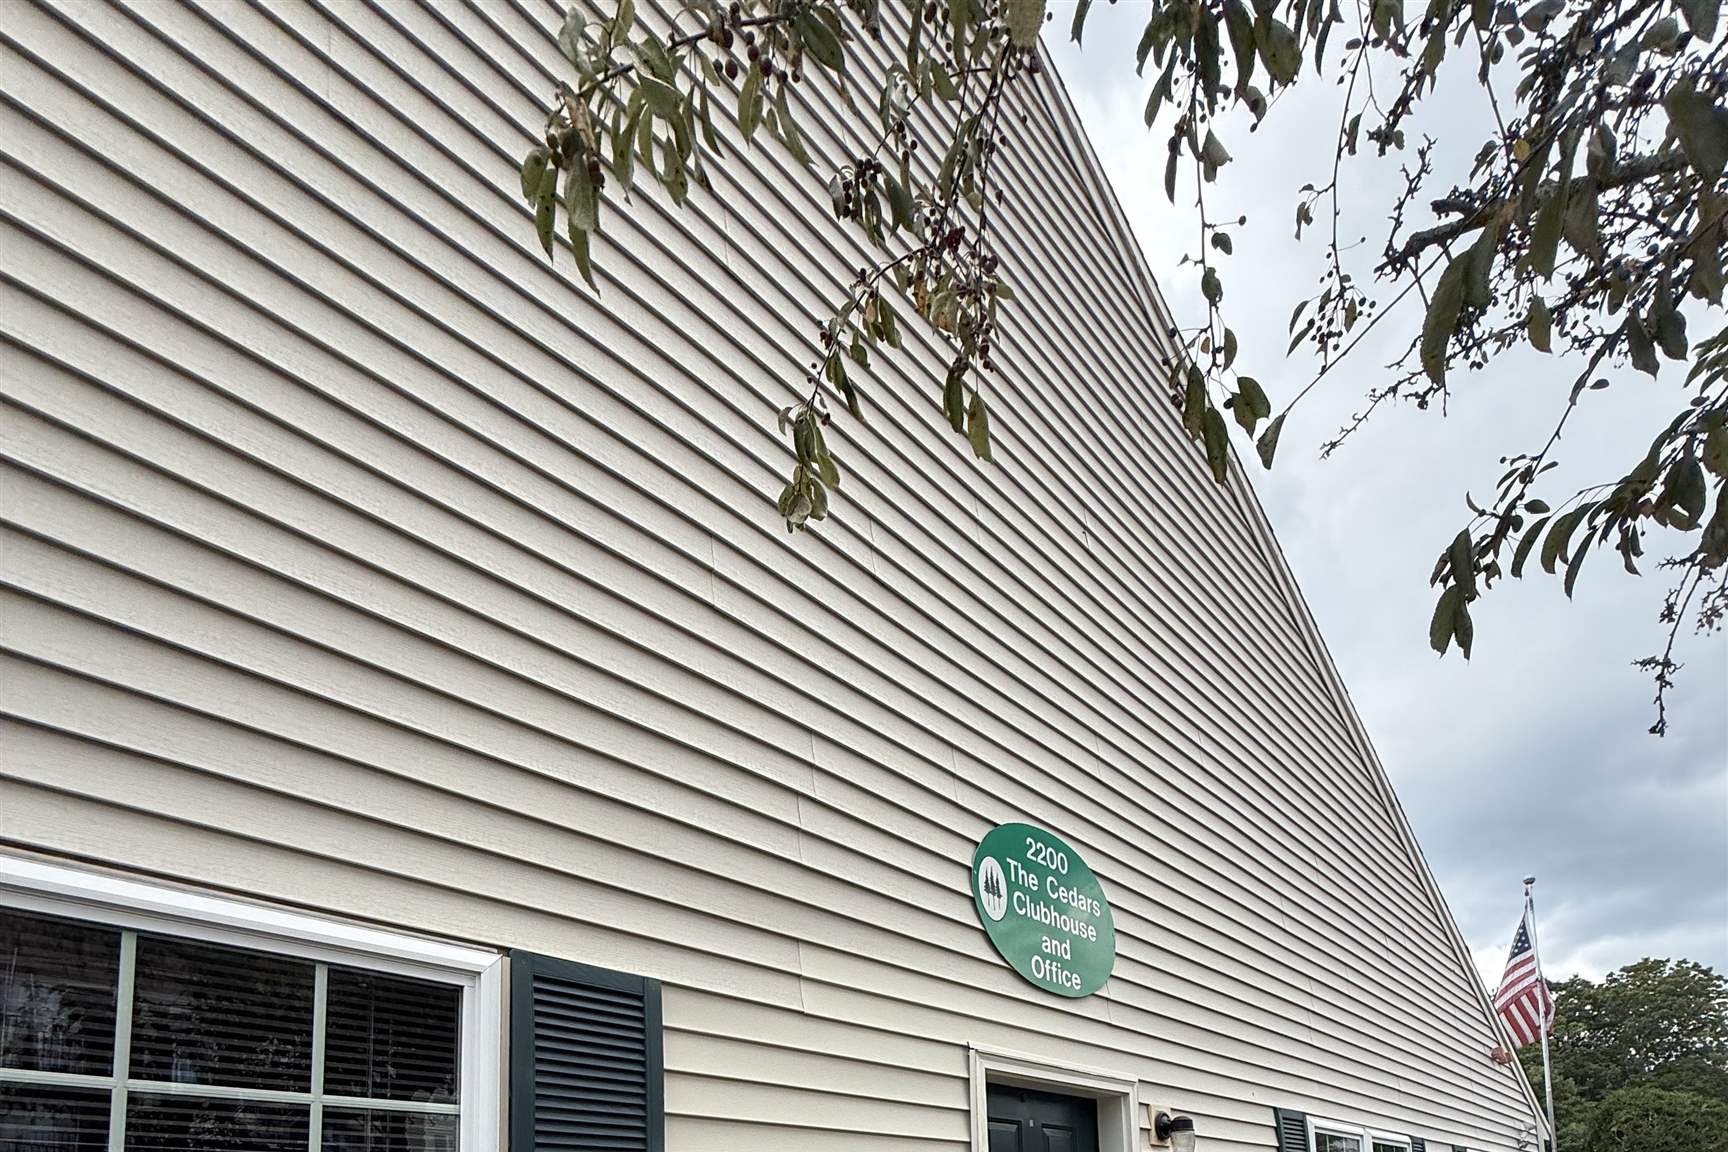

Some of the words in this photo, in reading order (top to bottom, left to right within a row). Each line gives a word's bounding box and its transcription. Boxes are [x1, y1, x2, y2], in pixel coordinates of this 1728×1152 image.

[1025, 837, 1068, 875] 2200
[1006, 857, 1039, 891] The
[1046, 876, 1101, 917] Cedars
[1013, 891, 1097, 942] Clubhouse
[1041, 935, 1071, 960] and
[1031, 955, 1082, 990] Office
